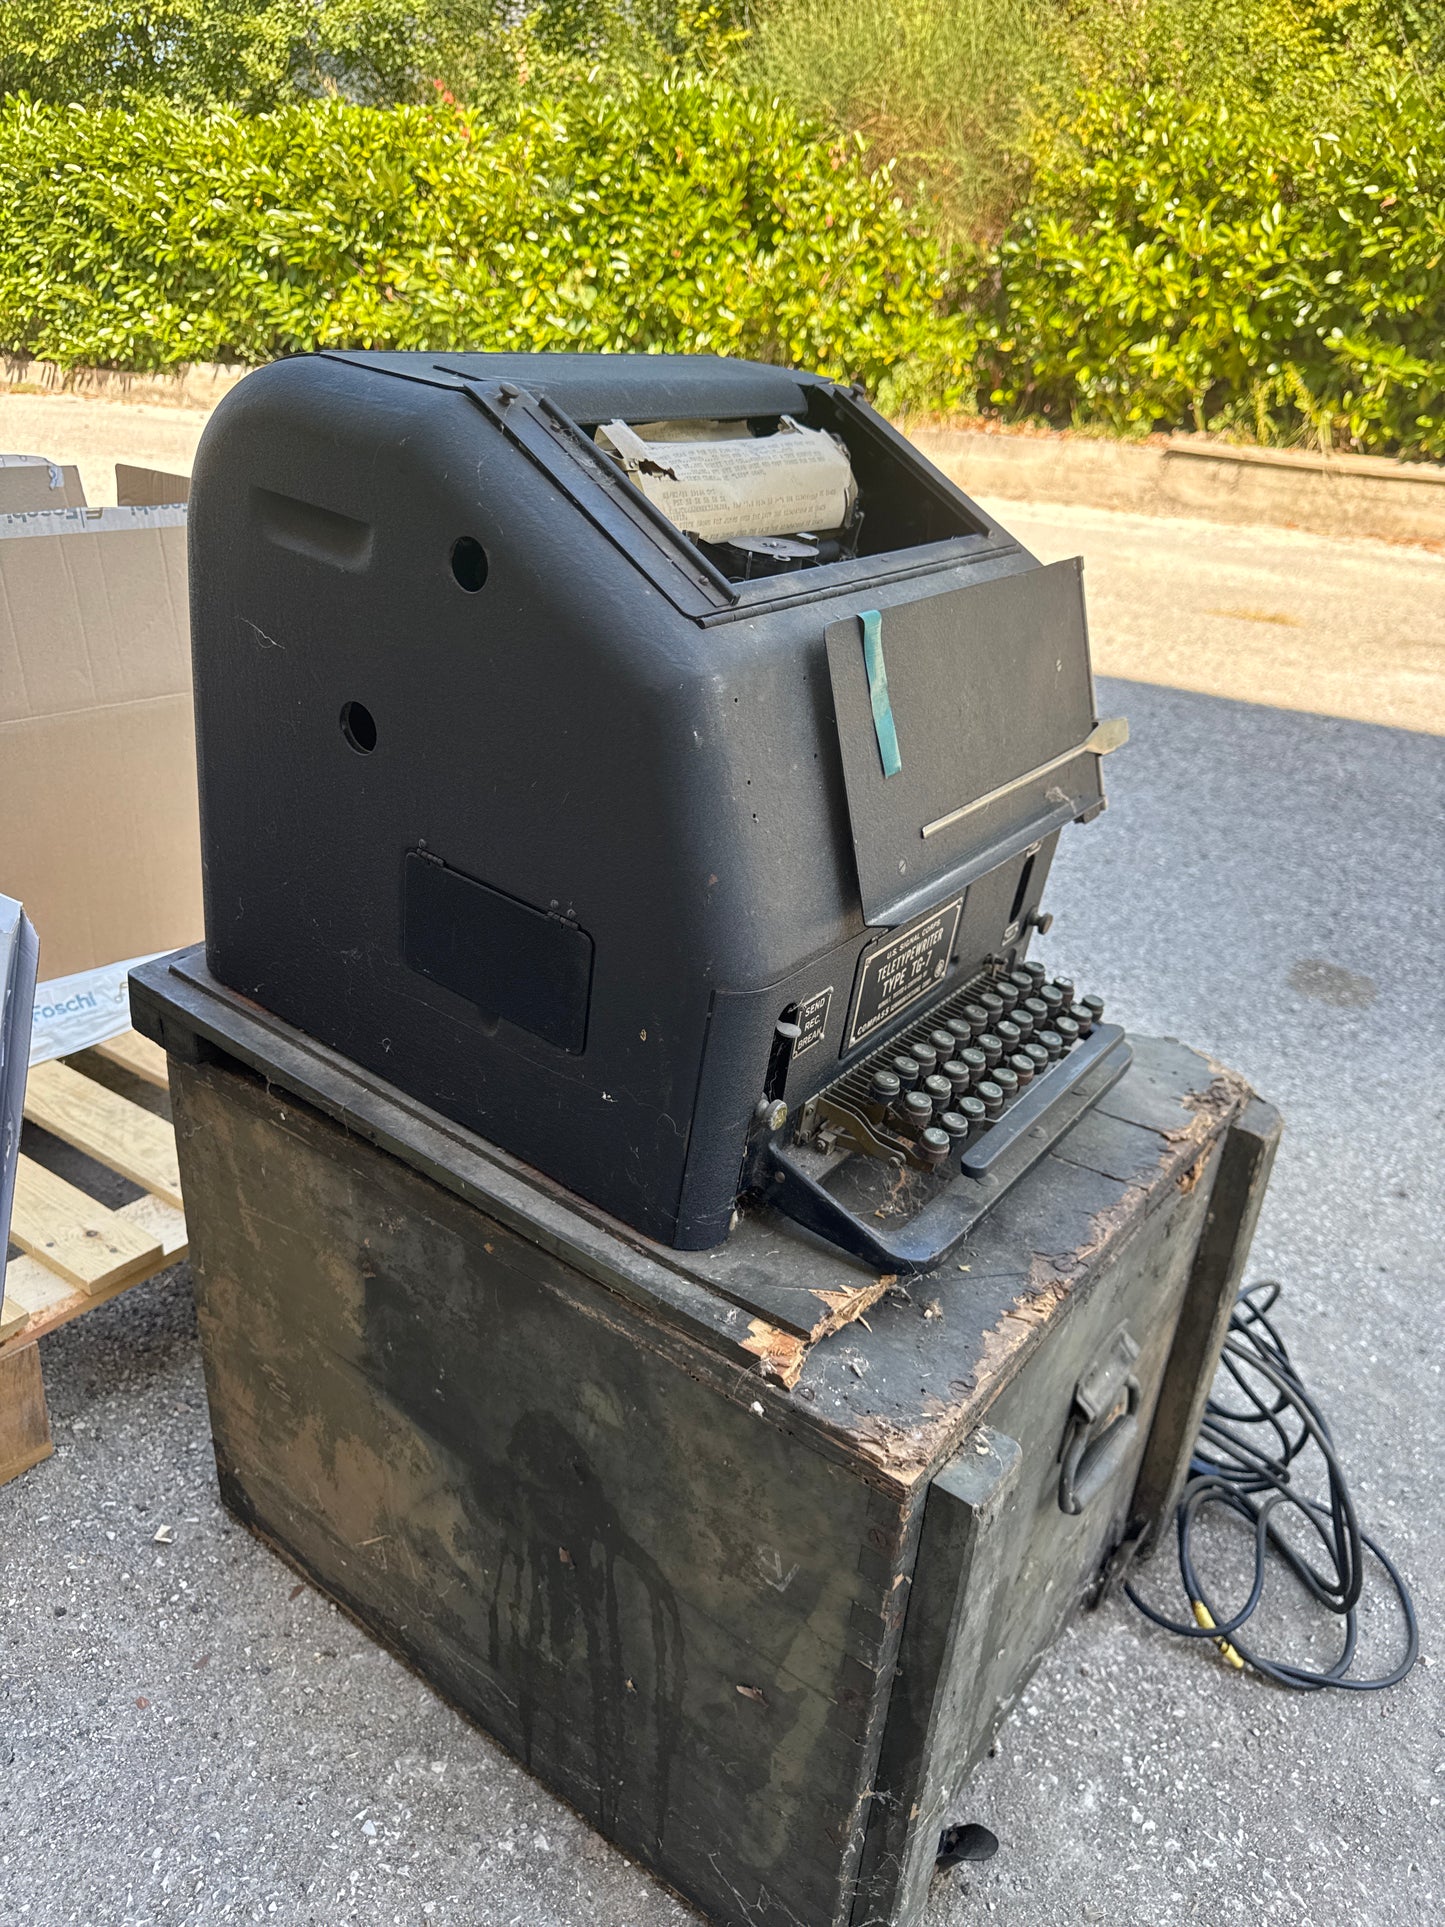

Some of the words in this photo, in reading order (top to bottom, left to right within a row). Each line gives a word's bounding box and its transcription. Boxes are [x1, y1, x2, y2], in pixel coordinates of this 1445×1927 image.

[899, 933, 920, 951] SIGNAL
[922, 919, 941, 936] CORPS
[878, 927, 944, 983] TELETYPEWRITER
[883, 967, 907, 997] TYPE
[911, 949, 933, 977] TG-7
[805, 998, 825, 1017] SEND
[857, 1006, 890, 1035] COMPASS
